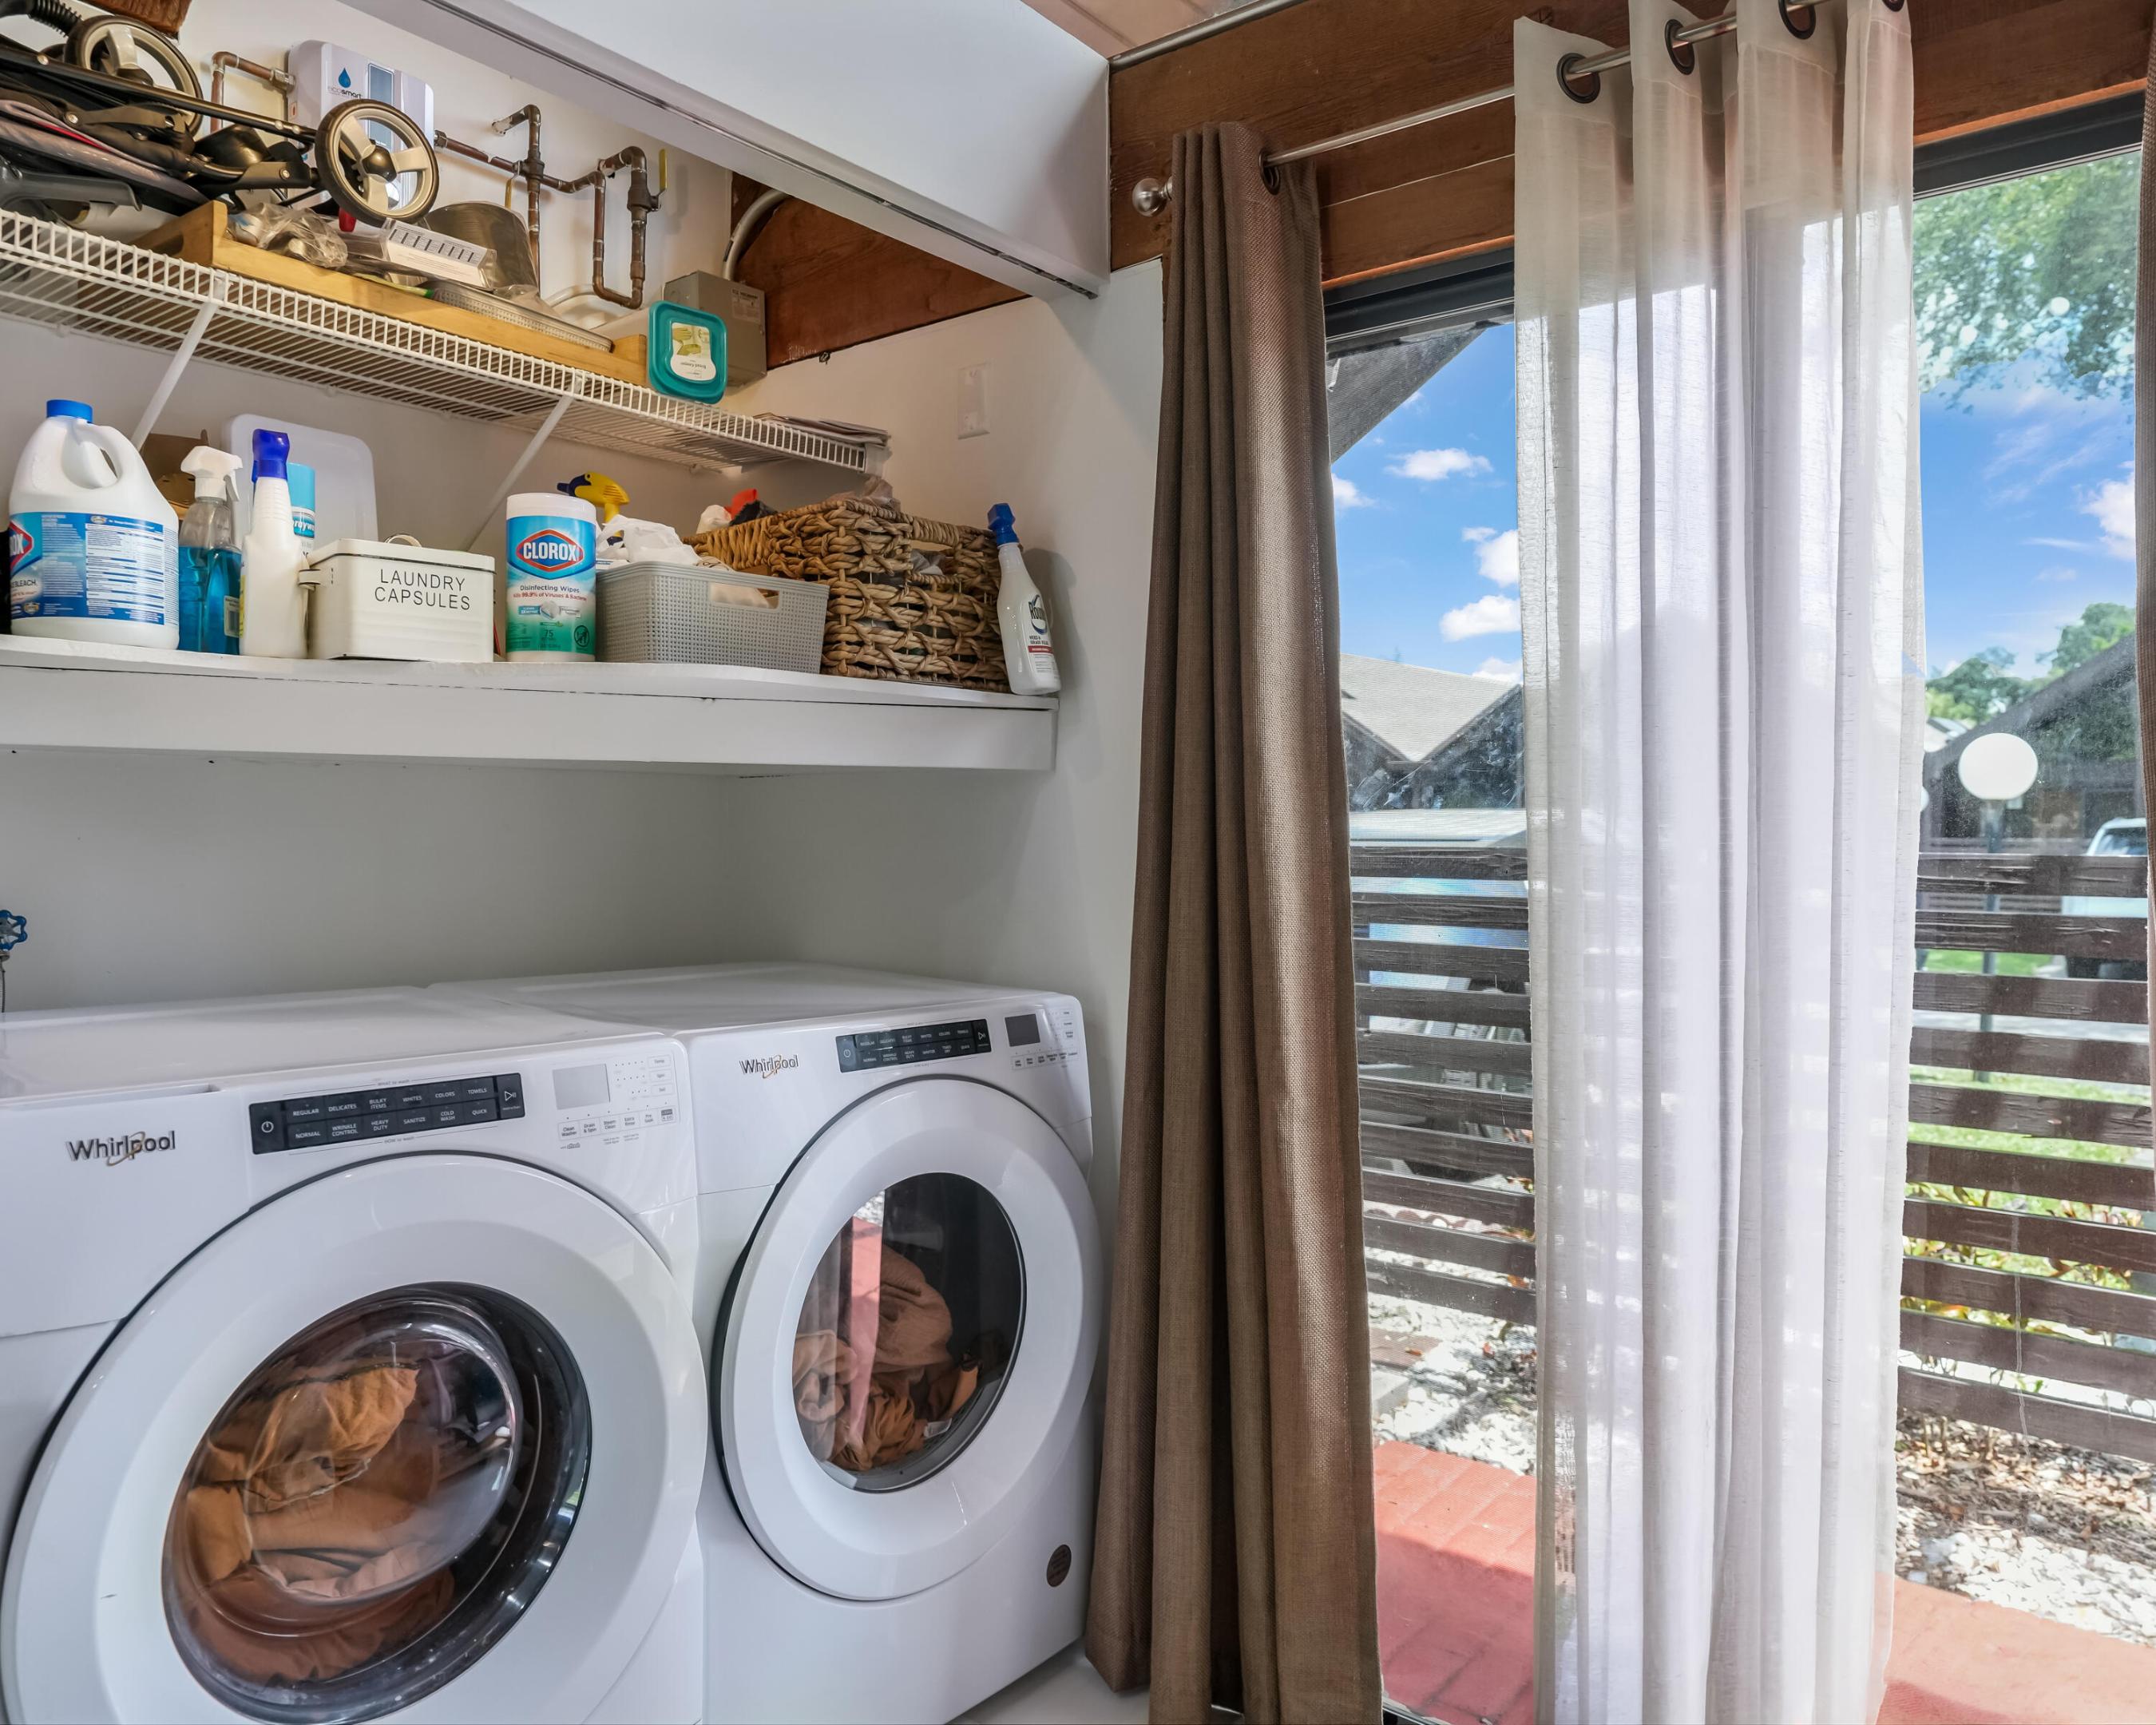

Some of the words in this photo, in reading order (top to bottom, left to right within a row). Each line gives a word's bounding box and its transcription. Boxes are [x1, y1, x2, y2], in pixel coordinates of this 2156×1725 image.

[523, 541, 577, 561] CLOROX
[380, 568, 466, 592] LAUNDRY
[375, 586, 470, 610] CAPSULES
[739, 1054, 799, 1075] Whirlpool
[292, 1108, 319, 1116] REGULAR
[328, 1104, 358, 1112] DELICATES
[403, 1116, 426, 1124] SANITIZE
[331, 1123, 357, 1132] WRINKLE
[295, 1131, 321, 1140] NORMAL
[331, 1128, 359, 1137] CONTROL
[65, 1130, 176, 1162] Whirlpool
